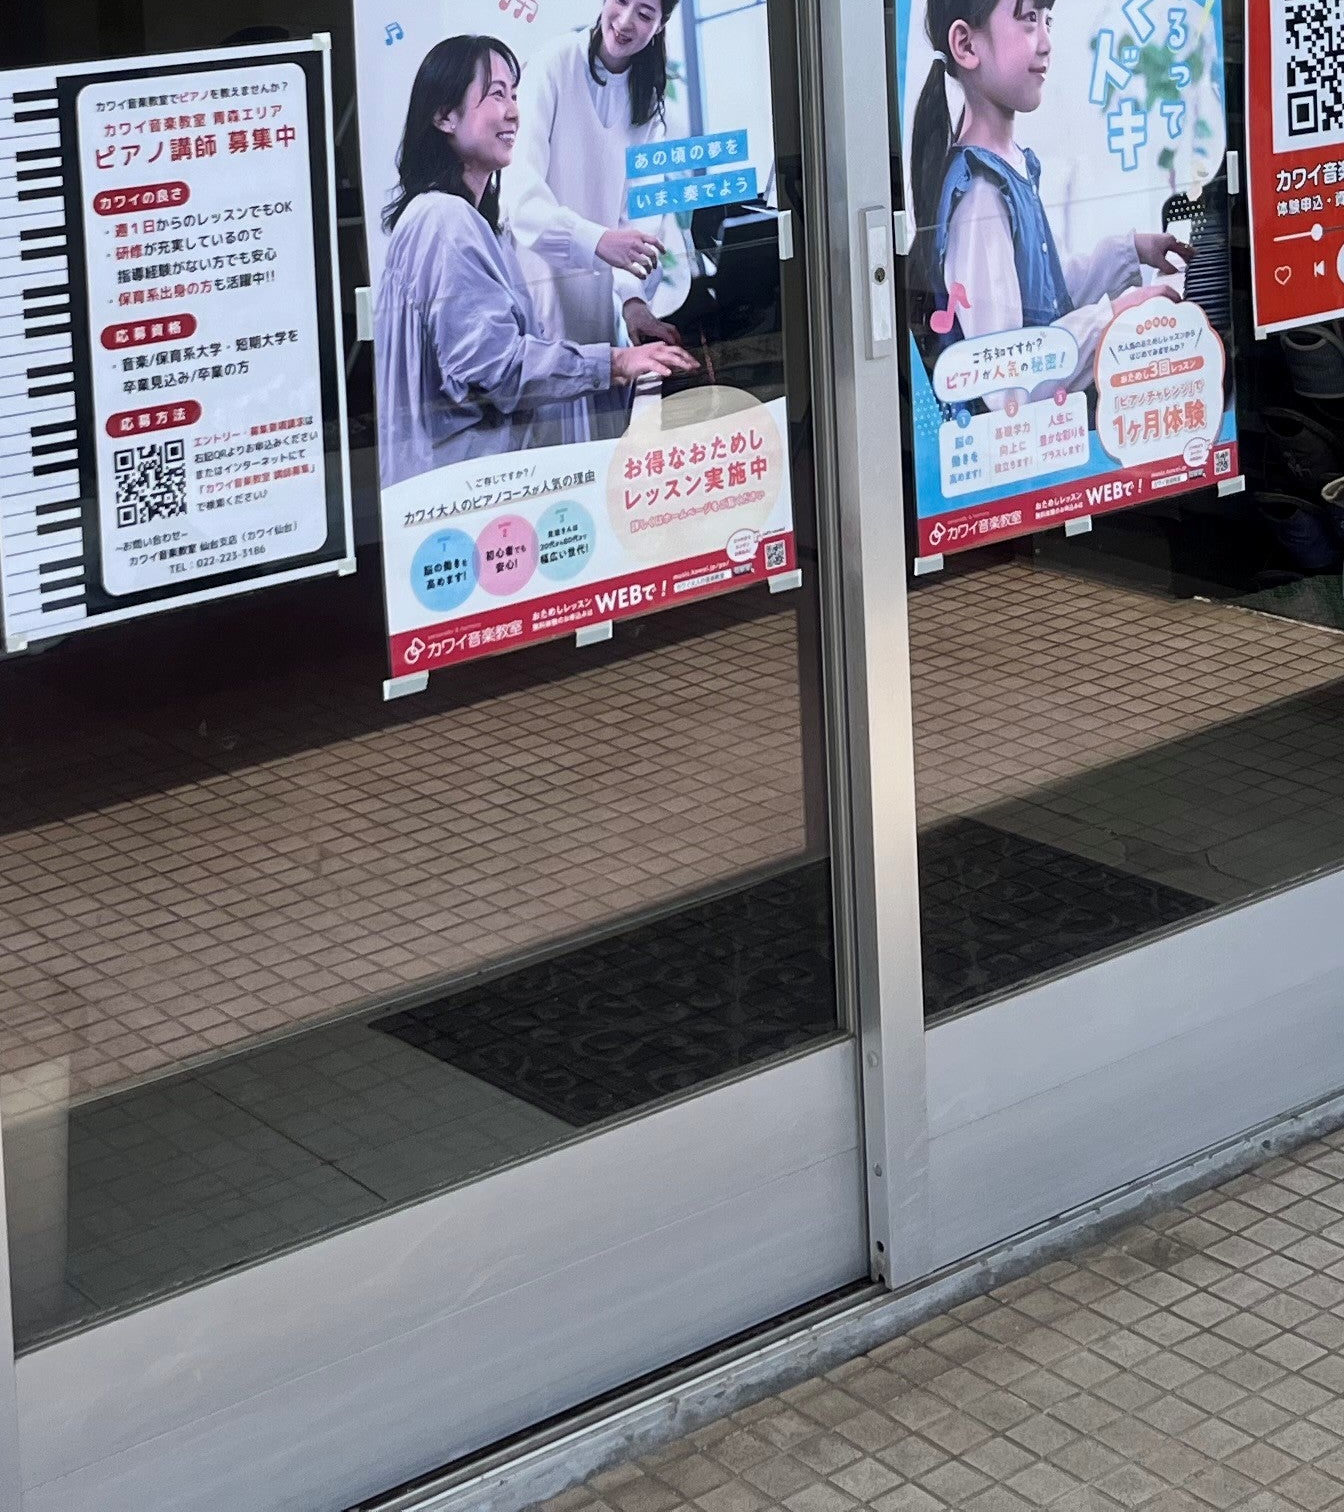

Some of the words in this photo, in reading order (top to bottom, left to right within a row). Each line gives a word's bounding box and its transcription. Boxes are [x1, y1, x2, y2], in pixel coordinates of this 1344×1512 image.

[104, 113, 207, 138] カワイ音楽教室
[213, 104, 283, 126] 青森エリア
[95, 134, 217, 169] ピアノ講師
[228, 124, 296, 154] 募集中
[634, 139, 738, 169] あの頃の夢を
[99, 188, 183, 210] カワイの良さ
[636, 177, 748, 208] いま、奏でよう
[117, 248, 277, 284] 指導経験がない方でも安心
[115, 321, 183, 344] 応募資格
[120, 408, 187, 432] 応募方法
[624, 429, 763, 480] お得なおためし
[625, 455, 767, 510] レッスン実施中
[947, 510, 1022, 541] カワイ音楽教室
[129, 544, 197, 567] カワイ音楽教室
[427, 619, 523, 659] カワイ音楽教室
